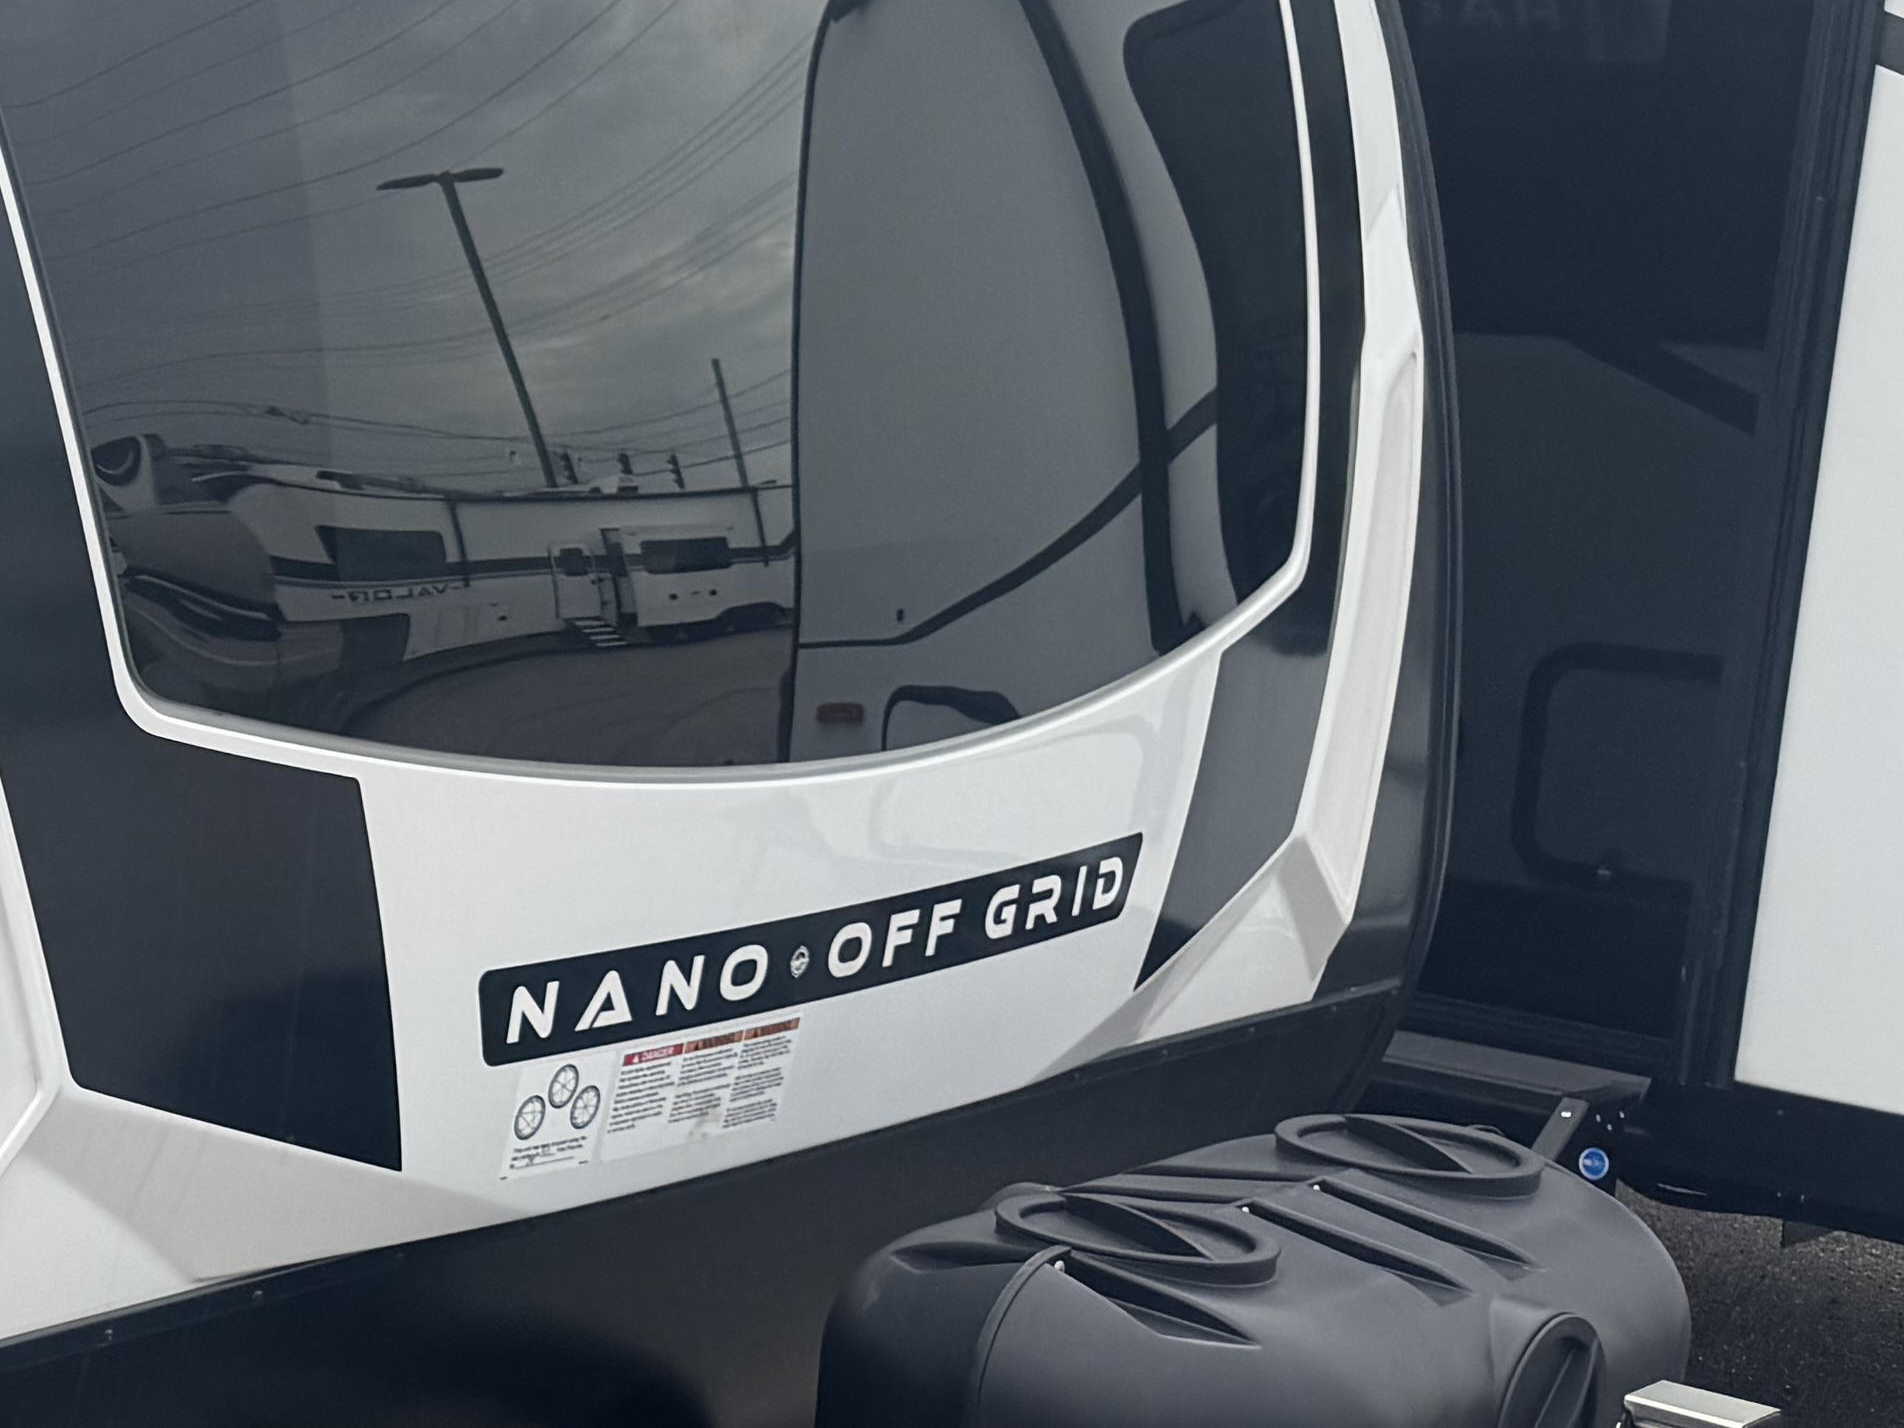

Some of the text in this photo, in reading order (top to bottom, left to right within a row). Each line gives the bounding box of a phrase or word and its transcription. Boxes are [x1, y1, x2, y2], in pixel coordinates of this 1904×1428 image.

[506, 856, 1125, 1045] NANO OFF GRID
